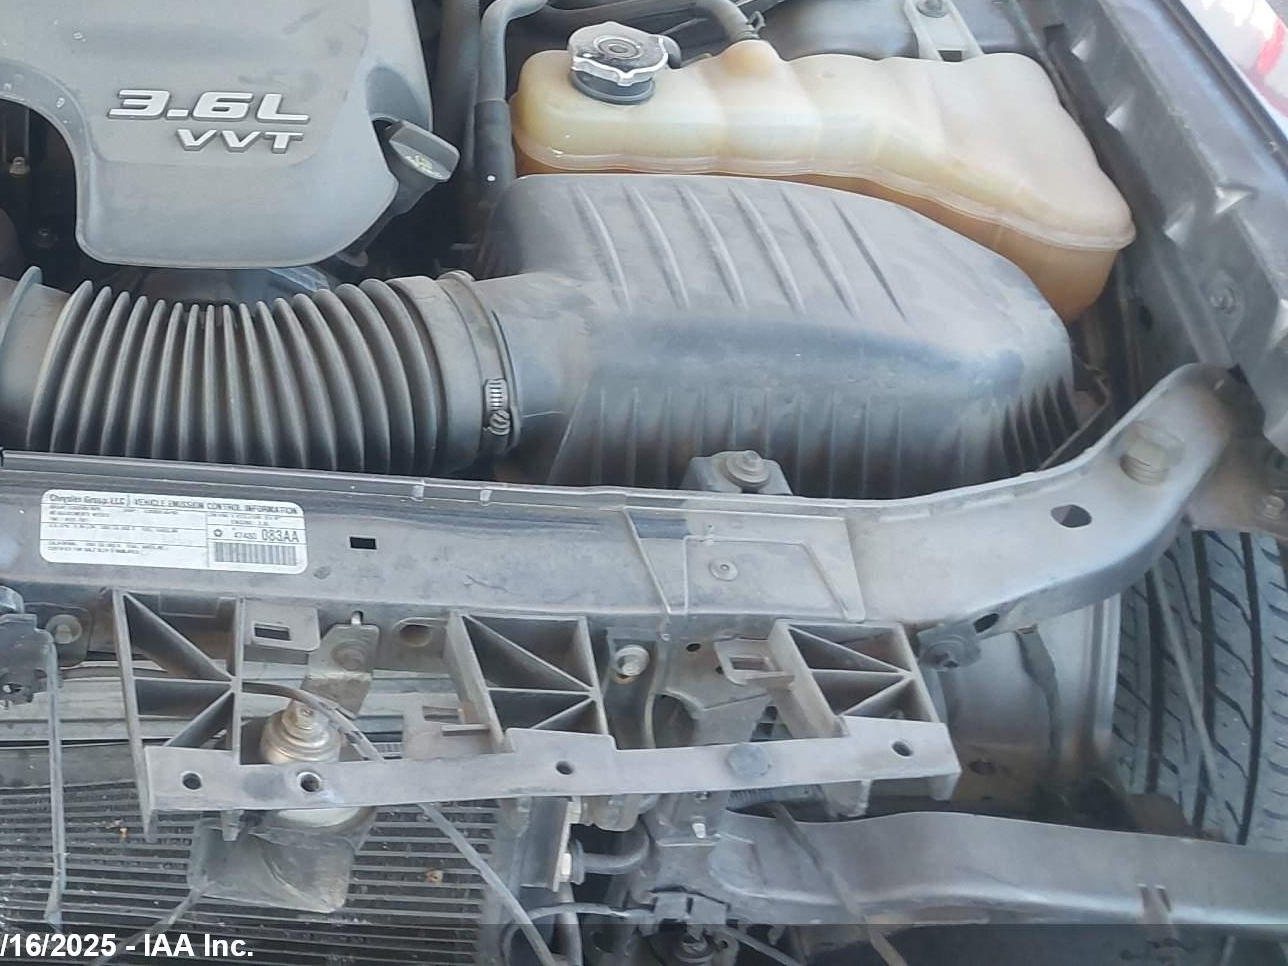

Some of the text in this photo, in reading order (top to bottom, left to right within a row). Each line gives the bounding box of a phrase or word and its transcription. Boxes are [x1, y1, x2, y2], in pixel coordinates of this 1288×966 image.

[107, 89, 311, 124] 3.6L
[176, 128, 305, 154] VVT
[135, 498, 166, 507] VEHICLE
[168, 500, 204, 509] EMISSION
[207, 502, 241, 511] CONTROL
[244, 504, 297, 514] INFORMATION
[261, 529, 300, 542] 083AA
